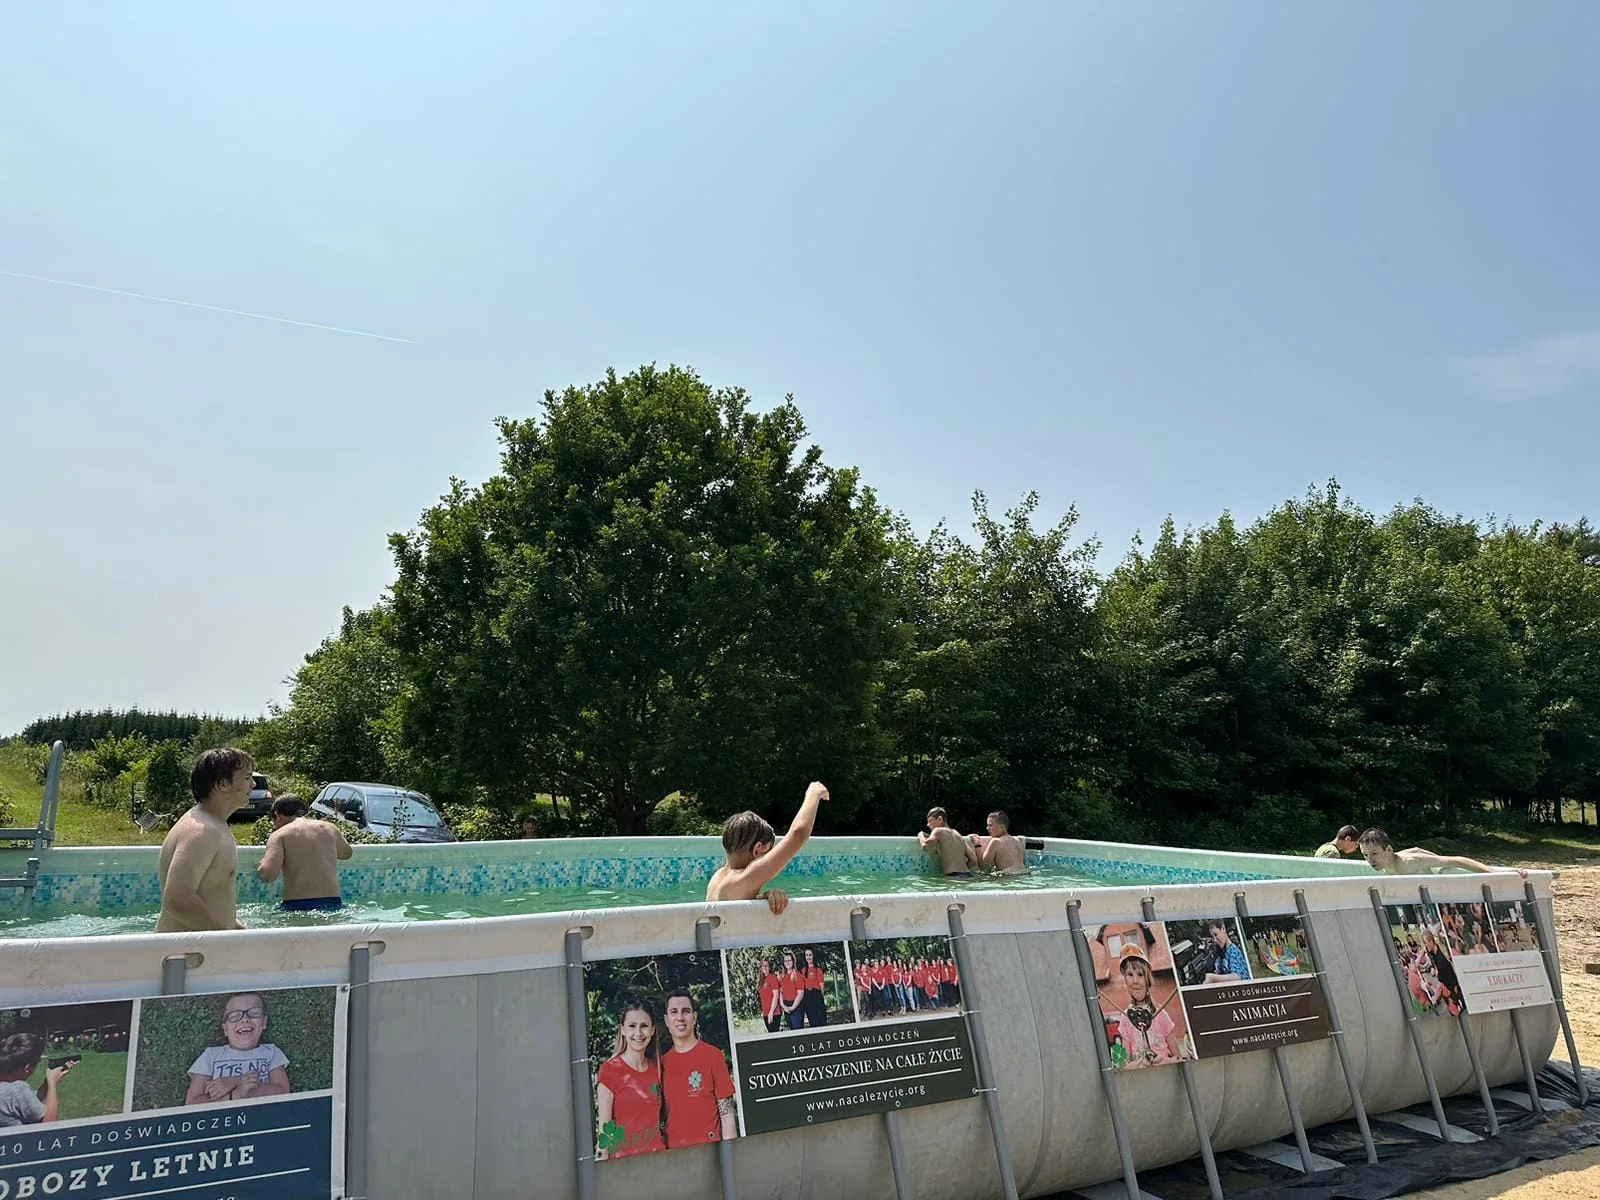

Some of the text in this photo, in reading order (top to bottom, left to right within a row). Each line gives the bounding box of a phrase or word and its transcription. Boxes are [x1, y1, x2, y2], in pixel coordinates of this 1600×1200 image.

[1228, 989, 1239, 999] LAT
[1232, 1003, 1287, 1022] ANIMACJA
[791, 1028, 920, 1054] 10 LAT DOŚWIADCZEŃ
[1232, 1028, 1298, 1046] www.nacalezycie.org
[748, 1059, 873, 1090] STOWARZYSZENIE
[875, 1055, 894, 1072] NA
[928, 1047, 963, 1064] ŻYCIE
[806, 1084, 926, 1112] www.nacalezycie.org
[38, 1135, 77, 1151] LAT
[91, 1112, 246, 1144] DOŚWIADCZEŃ
[129, 1145, 254, 1182] LETNIE
